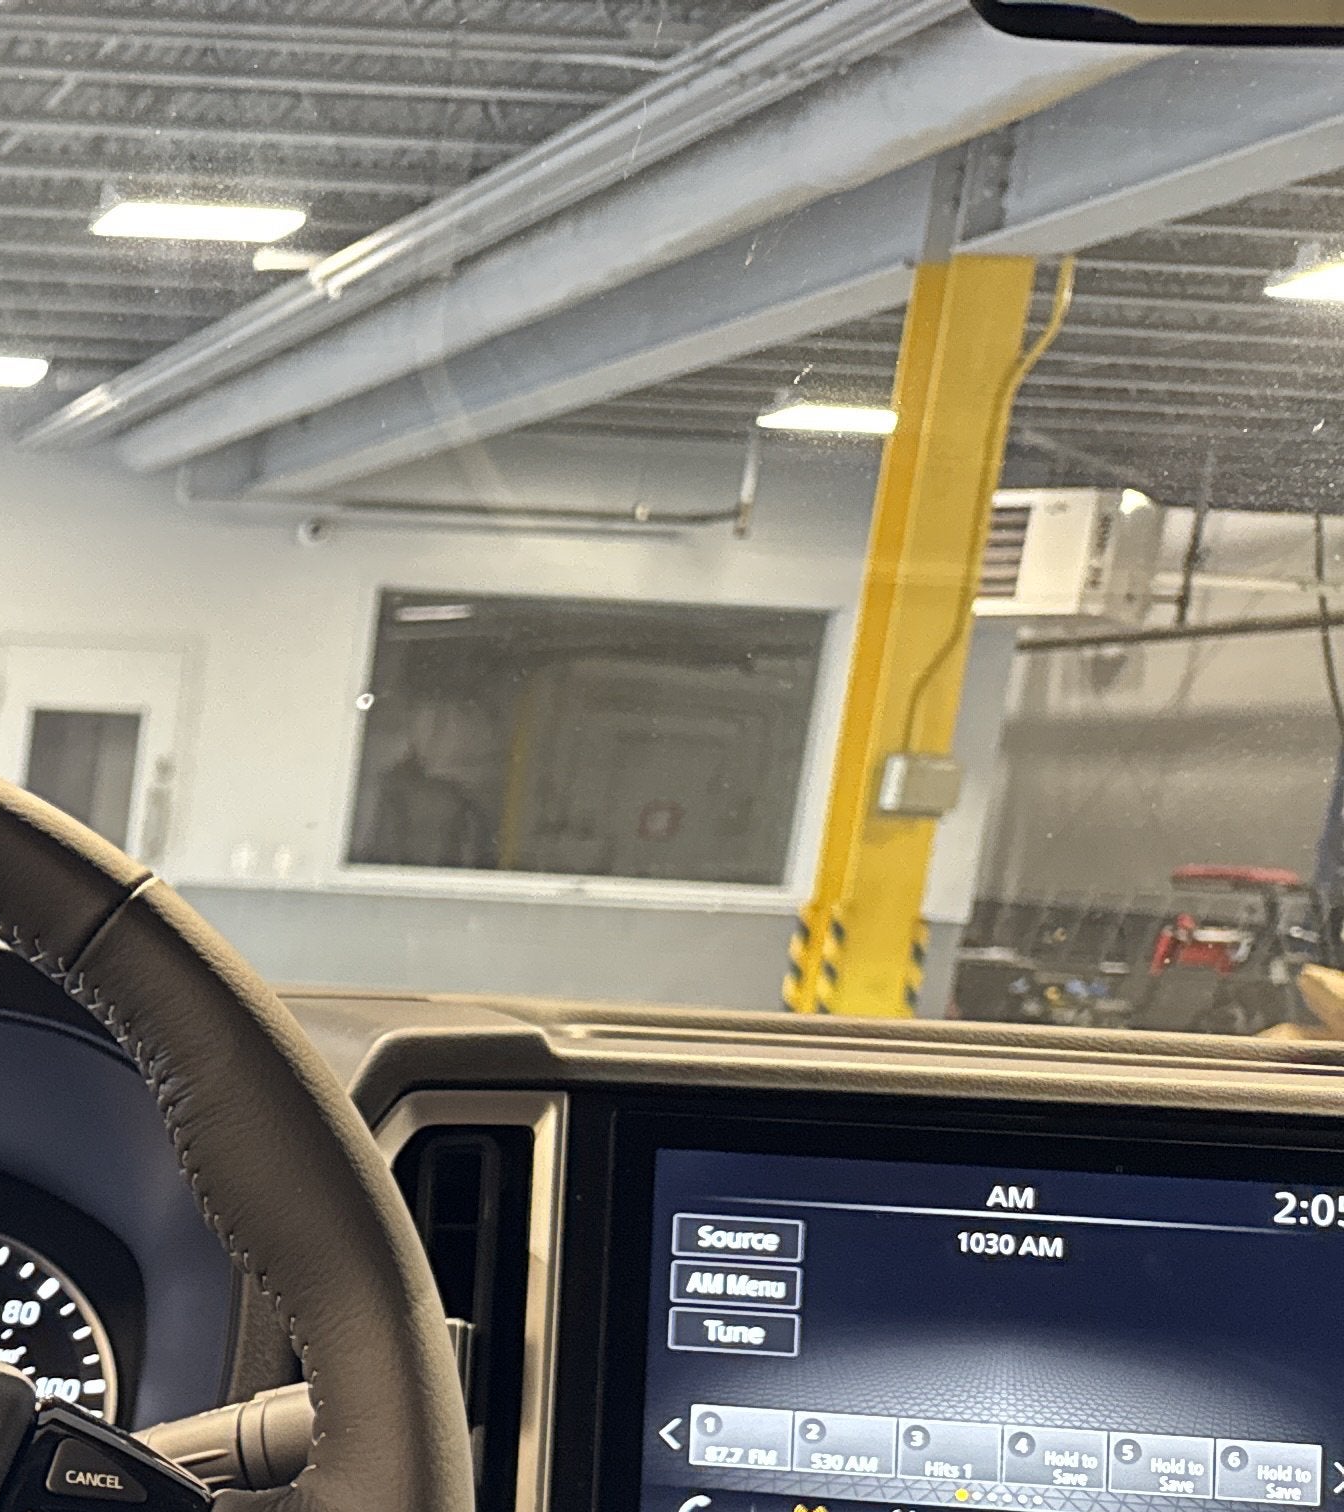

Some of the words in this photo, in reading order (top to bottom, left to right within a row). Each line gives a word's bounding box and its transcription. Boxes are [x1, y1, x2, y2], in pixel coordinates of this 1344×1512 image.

[985, 1185, 1036, 1210] AM
[696, 1224, 781, 1252] Source
[956, 1231, 1015, 1256] 1030
[1017, 1235, 1065, 1259] AM
[686, 1271, 724, 1295] AM
[726, 1274, 787, 1300] Menu
[1, 1299, 41, 1326] 80
[703, 1319, 766, 1346] Tune
[35, 1376, 81, 1403] 100
[703, 1416, 715, 1433] 1
[806, 1424, 821, 1440] 2
[910, 1431, 924, 1447] 3
[1014, 1437, 1029, 1453] 4
[748, 1449, 778, 1467] FM
[1044, 1450, 1078, 1468] Hold
[1079, 1454, 1098, 1469] to
[1121, 1444, 1134, 1460] 5
[1227, 1451, 1240, 1467] 6
[810, 1453, 844, 1471] 530
[845, 1456, 879, 1473] AM
[924, 1461, 959, 1479] Hits
[962, 1463, 973, 1479] 1
[1150, 1458, 1185, 1475] Hold
[1186, 1461, 1205, 1477] to
[64, 1469, 124, 1491] CANCEL
[1052, 1469, 1089, 1487] Save
[1257, 1465, 1292, 1482] Hold
[1293, 1469, 1312, 1484] to
[1158, 1476, 1195, 1495] Save
[1265, 1484, 1302, 1501] Save
